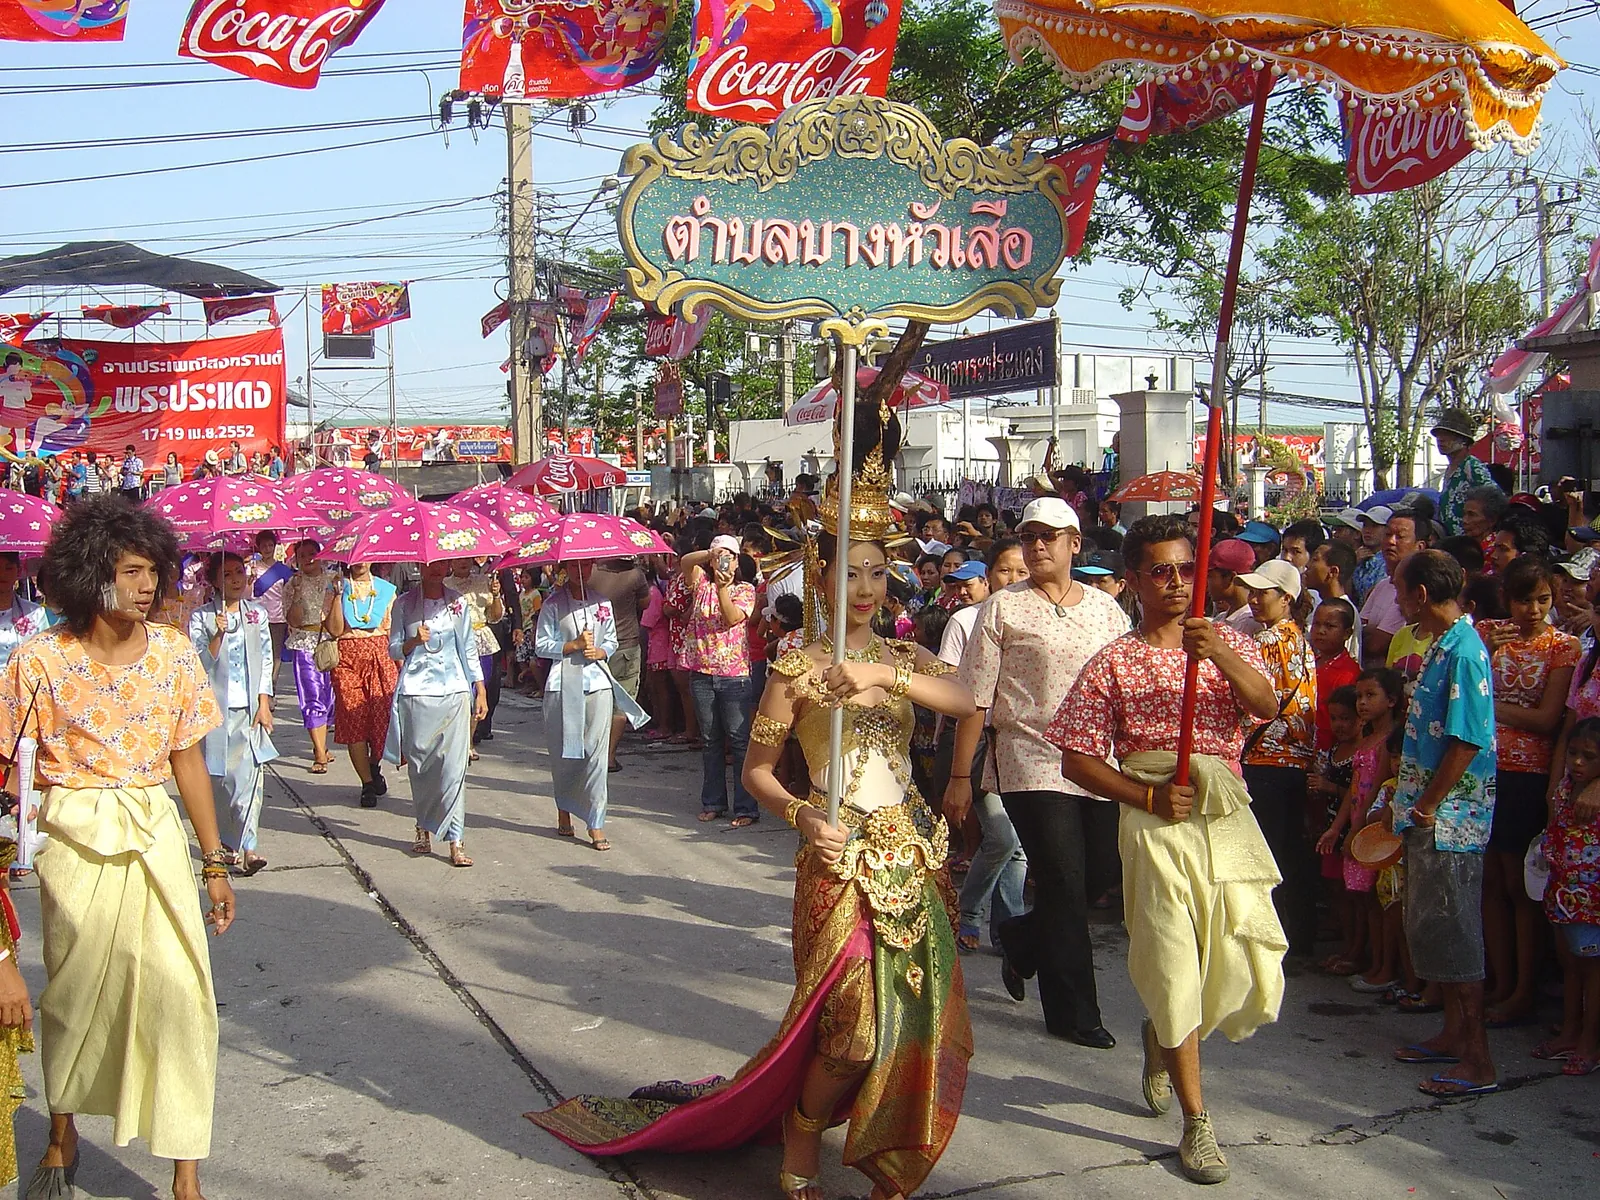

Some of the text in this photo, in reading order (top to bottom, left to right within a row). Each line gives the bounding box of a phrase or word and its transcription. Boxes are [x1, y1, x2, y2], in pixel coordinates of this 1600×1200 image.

[189, 0, 365, 73] Coca-C
[664, 195, 1034, 271] ตำบลบางหัวเสือ
[103, 350, 282, 374] งานประเพณีสงกรานต์
[115, 379, 272, 413] พระประแดง
[142, 427, 184, 441] 17-19
